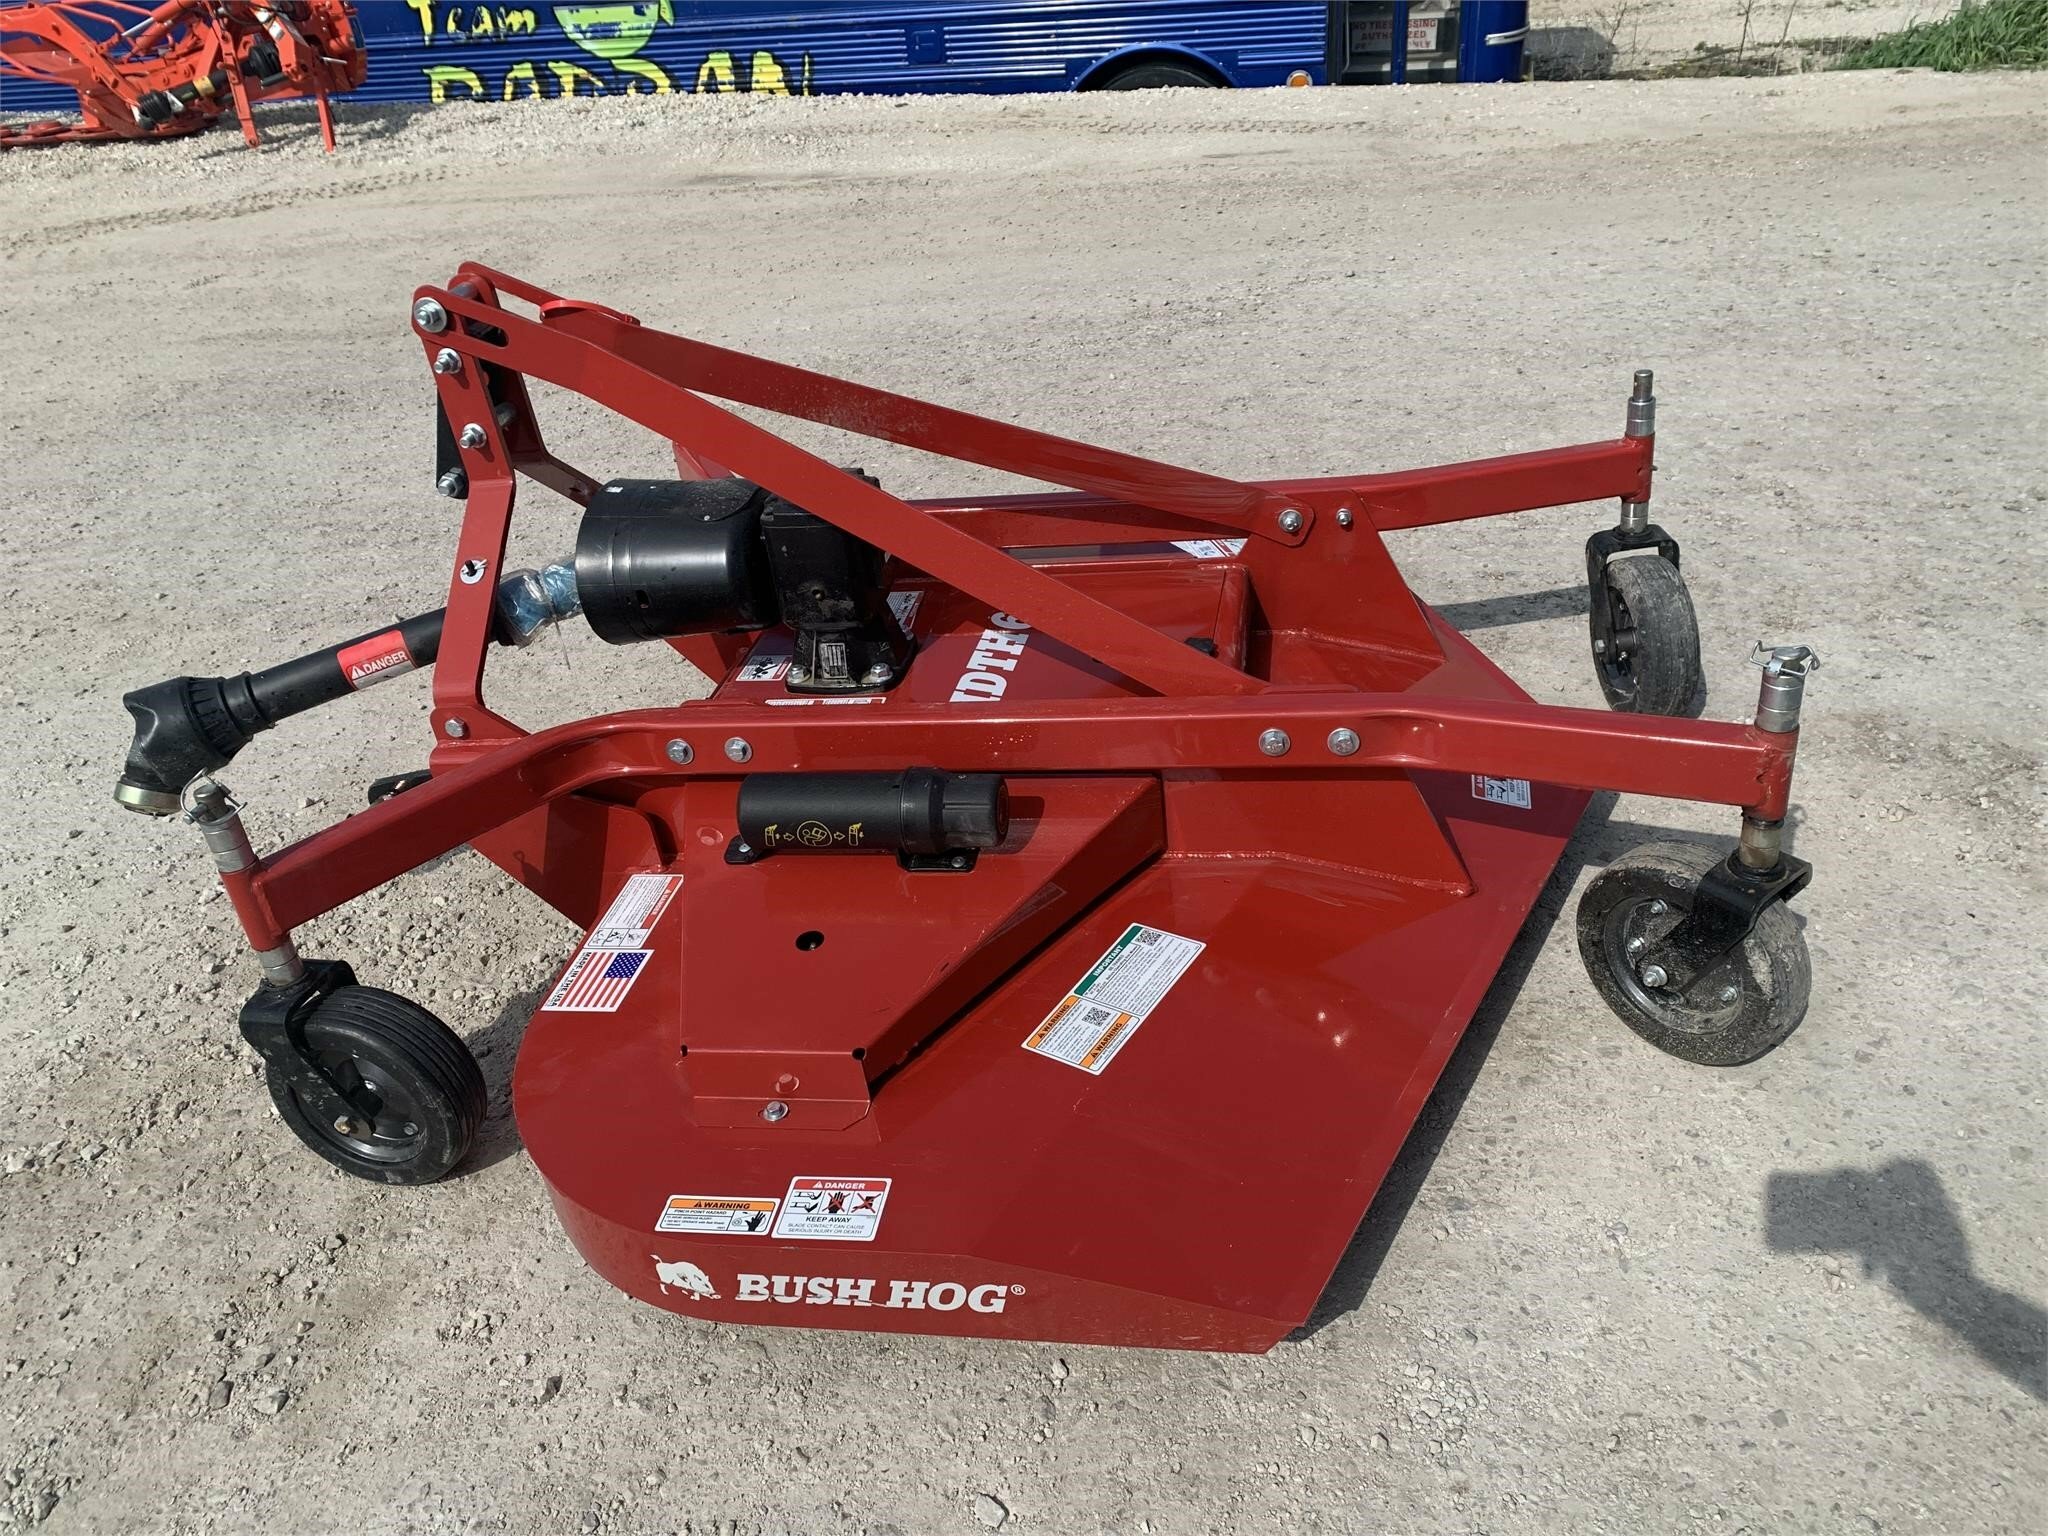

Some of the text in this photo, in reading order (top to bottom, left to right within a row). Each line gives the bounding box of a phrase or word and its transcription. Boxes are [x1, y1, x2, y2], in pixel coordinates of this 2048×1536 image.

[1370, 19, 1436, 29] TRESSSING
[1361, 31, 1426, 41] AUTHZED
[362, 650, 408, 674] DANGER
[575, 951, 592, 970] MADE
[1093, 945, 1124, 977] IMPORTANT
[1041, 1004, 1070, 1033] WARNING
[1095, 1022, 1123, 1052] WARNING
[823, 1182, 866, 1190] DANGER
[703, 1202, 751, 1210] WARNING
[735, 1273, 876, 1307] BUSH
